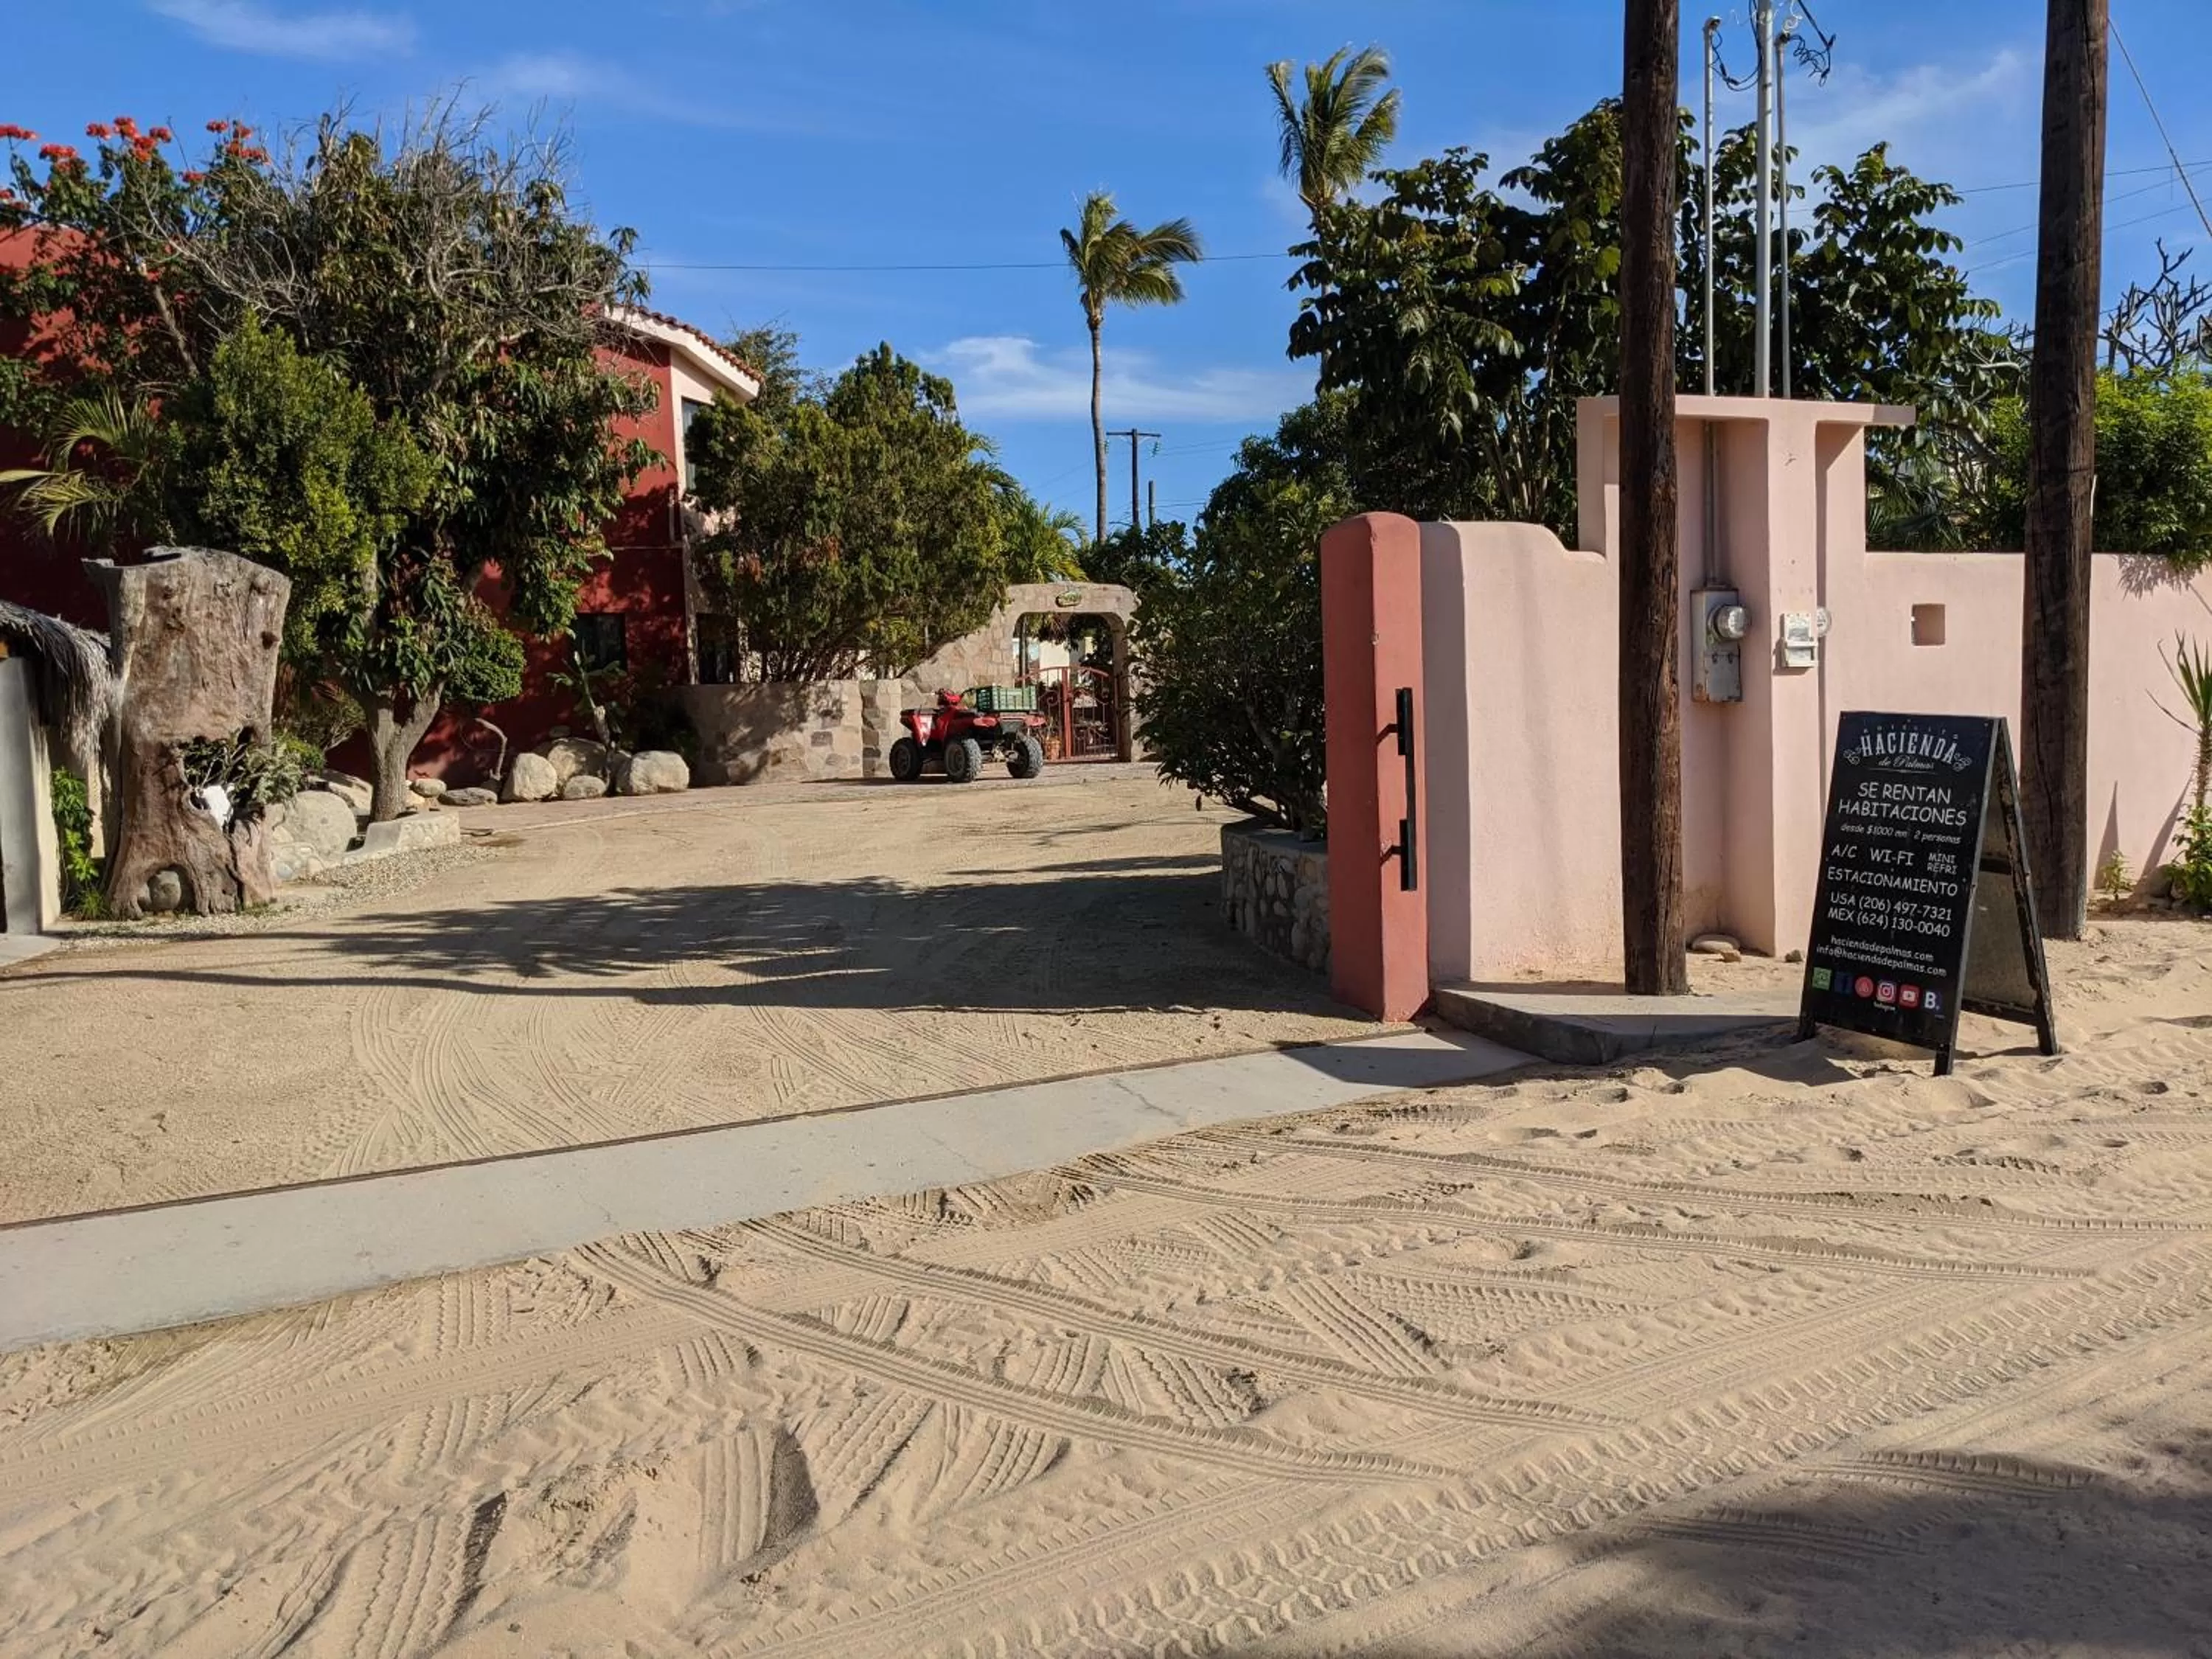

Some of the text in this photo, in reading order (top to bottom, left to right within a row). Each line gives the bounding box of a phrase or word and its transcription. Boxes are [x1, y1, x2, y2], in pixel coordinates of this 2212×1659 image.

[1860, 731, 1958, 765] HACIENDA
[1878, 756, 1892, 767] de
[1858, 782, 1951, 804] SE RENTAN
[1838, 799, 1967, 827] HABITACIONES
[1840, 824, 1864, 833] desde
[1913, 830, 1921, 840] 2
[1921, 832, 1961, 844] personas
[1831, 844, 1916, 866] A/C WI-FI
[1927, 862, 1958, 875] REFRI
[1928, 852, 1956, 863] MINI
[1828, 866, 1958, 897] ESTACIONAMIENTO
[1830, 891, 1952, 921] USA (206) 497-7321
[1828, 907, 1950, 937] MEX (624) 130-0040
[1816, 944, 1947, 977] info@haciendadepalmas.com
[1831, 935, 1935, 962] haciendadepalmas.com
